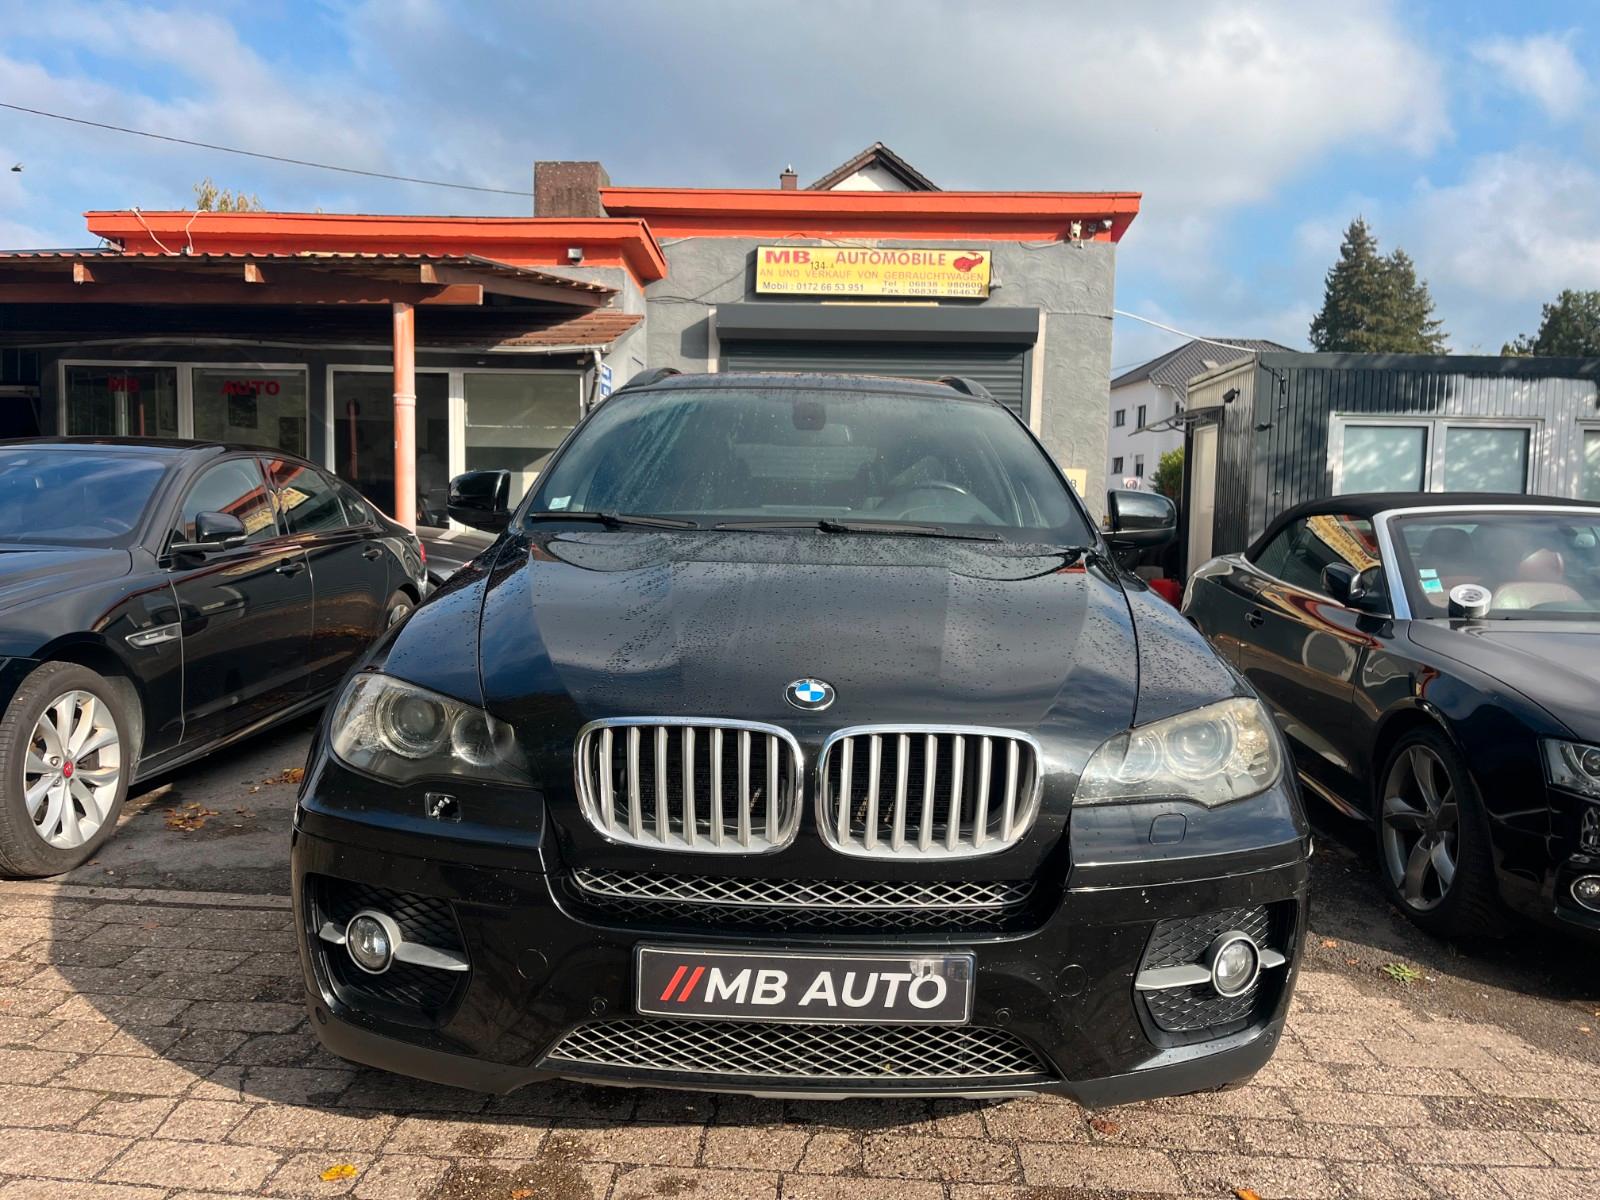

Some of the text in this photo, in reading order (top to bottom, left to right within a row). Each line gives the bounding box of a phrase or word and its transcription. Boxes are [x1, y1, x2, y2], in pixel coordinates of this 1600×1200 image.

[765, 250, 946, 266] MB AUTOMOBILE
[760, 269, 984, 281] AN UND VERKAUF VON GEBRAUCHTWAGEN
[763, 281, 864, 292] Mobil 0172 66 53 951
[221, 380, 281, 396] AUTO
[798, 971, 947, 1009] AUTO
